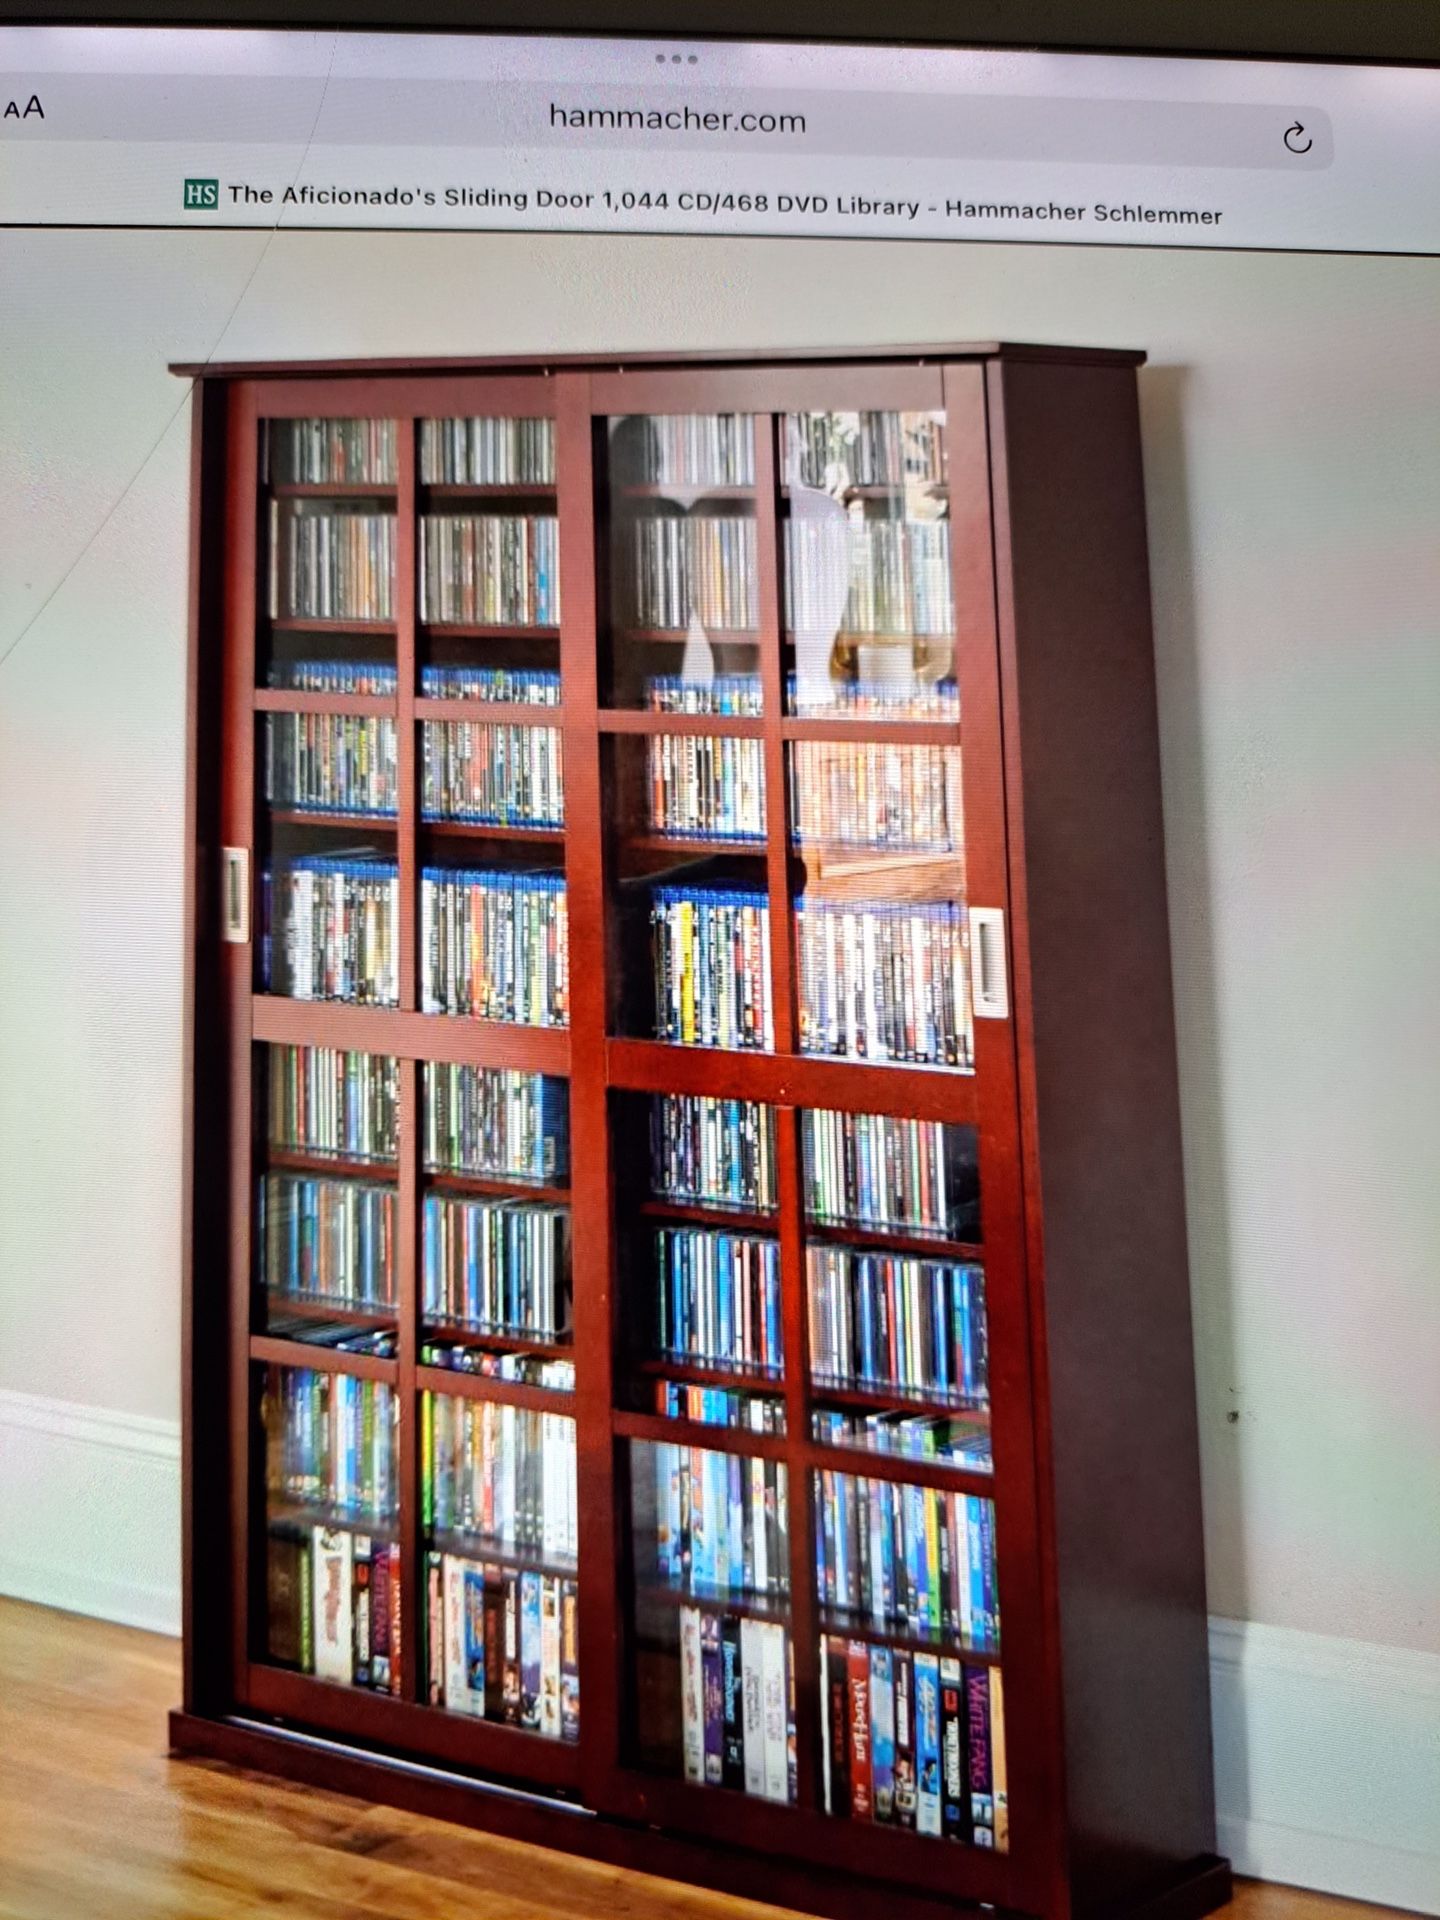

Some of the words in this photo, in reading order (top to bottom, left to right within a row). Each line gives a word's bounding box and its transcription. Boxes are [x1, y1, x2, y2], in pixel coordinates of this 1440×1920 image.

[550, 102, 806, 133] hammacher.com
[186, 184, 216, 205] HS
[228, 184, 274, 204] The
[281, 185, 436, 206] Aficionado's
[444, 187, 528, 212] Sliding
[536, 189, 595, 209] Door
[602, 190, 670, 213] 1,044
[677, 192, 769, 215] CD/468
[777, 195, 829, 214] DVD
[836, 196, 920, 220] Library
[945, 199, 1087, 222] Hammacher
[1093, 203, 1223, 225] Schlemmer
